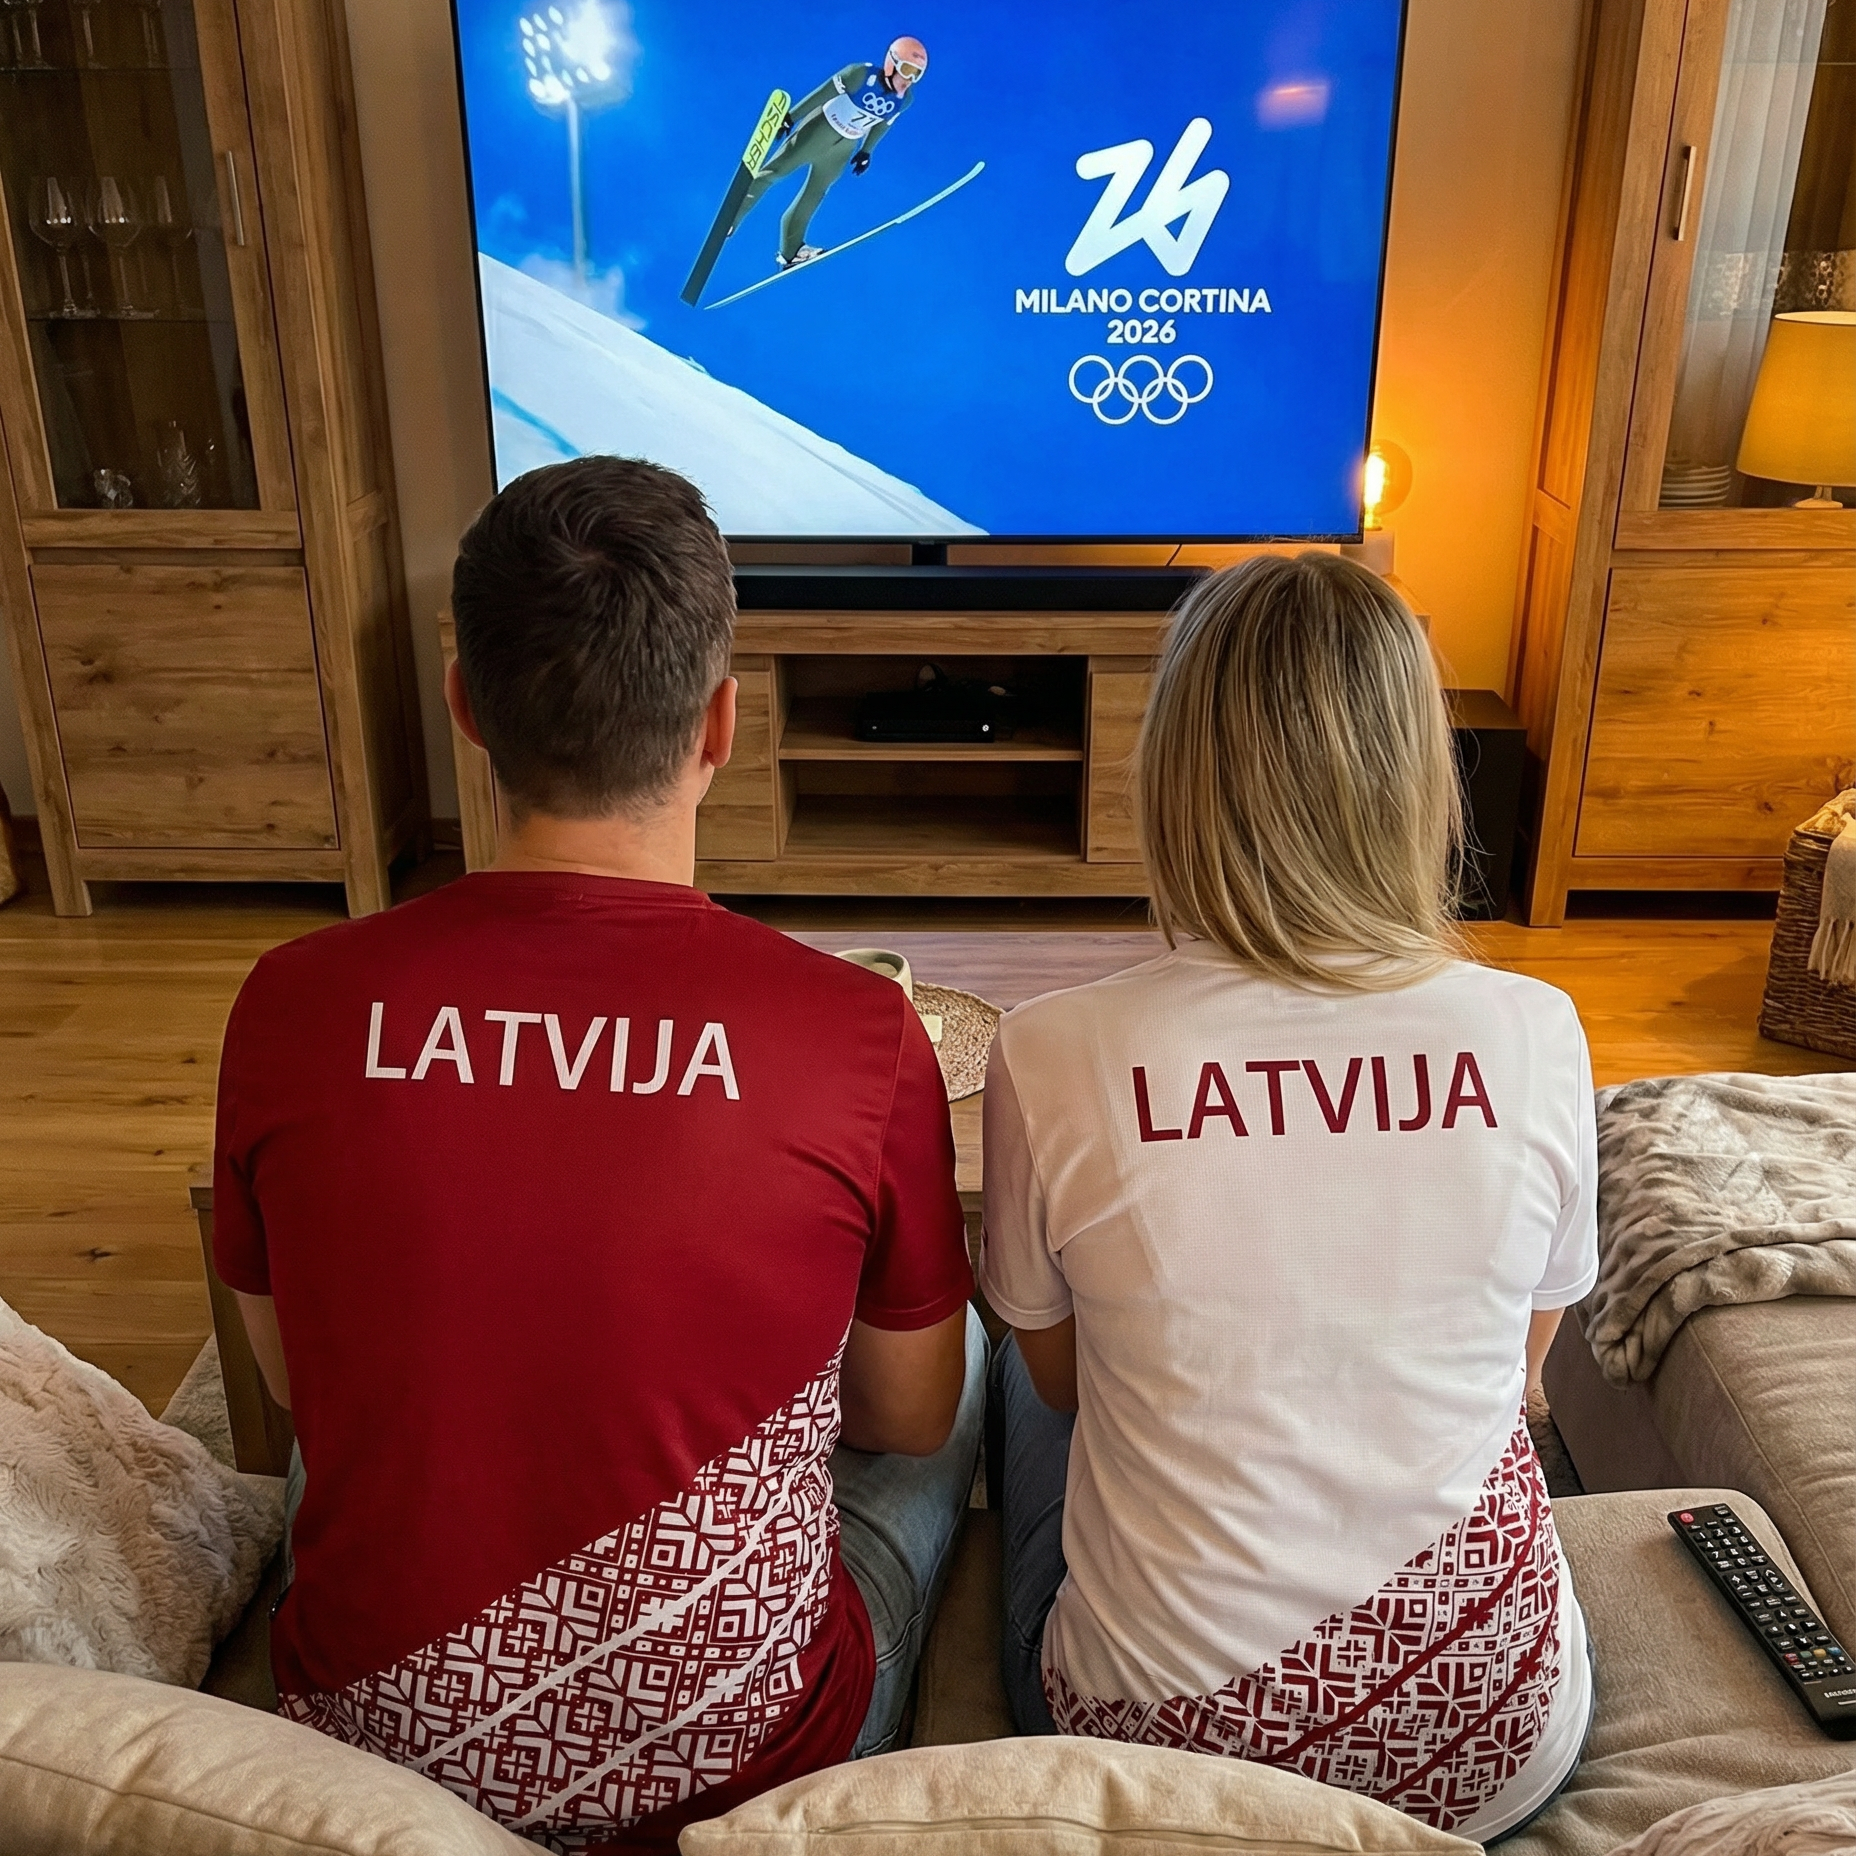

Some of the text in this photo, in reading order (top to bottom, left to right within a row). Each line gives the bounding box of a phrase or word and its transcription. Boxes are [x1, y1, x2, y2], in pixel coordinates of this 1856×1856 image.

[747, 91, 787, 170] FISCHER
[1015, 288, 1272, 313] MILANO CORTINA
[1106, 319, 1177, 344] 2026
[365, 1002, 740, 1101] LATVIJA
[1132, 1051, 1498, 1142] LATVIJA
